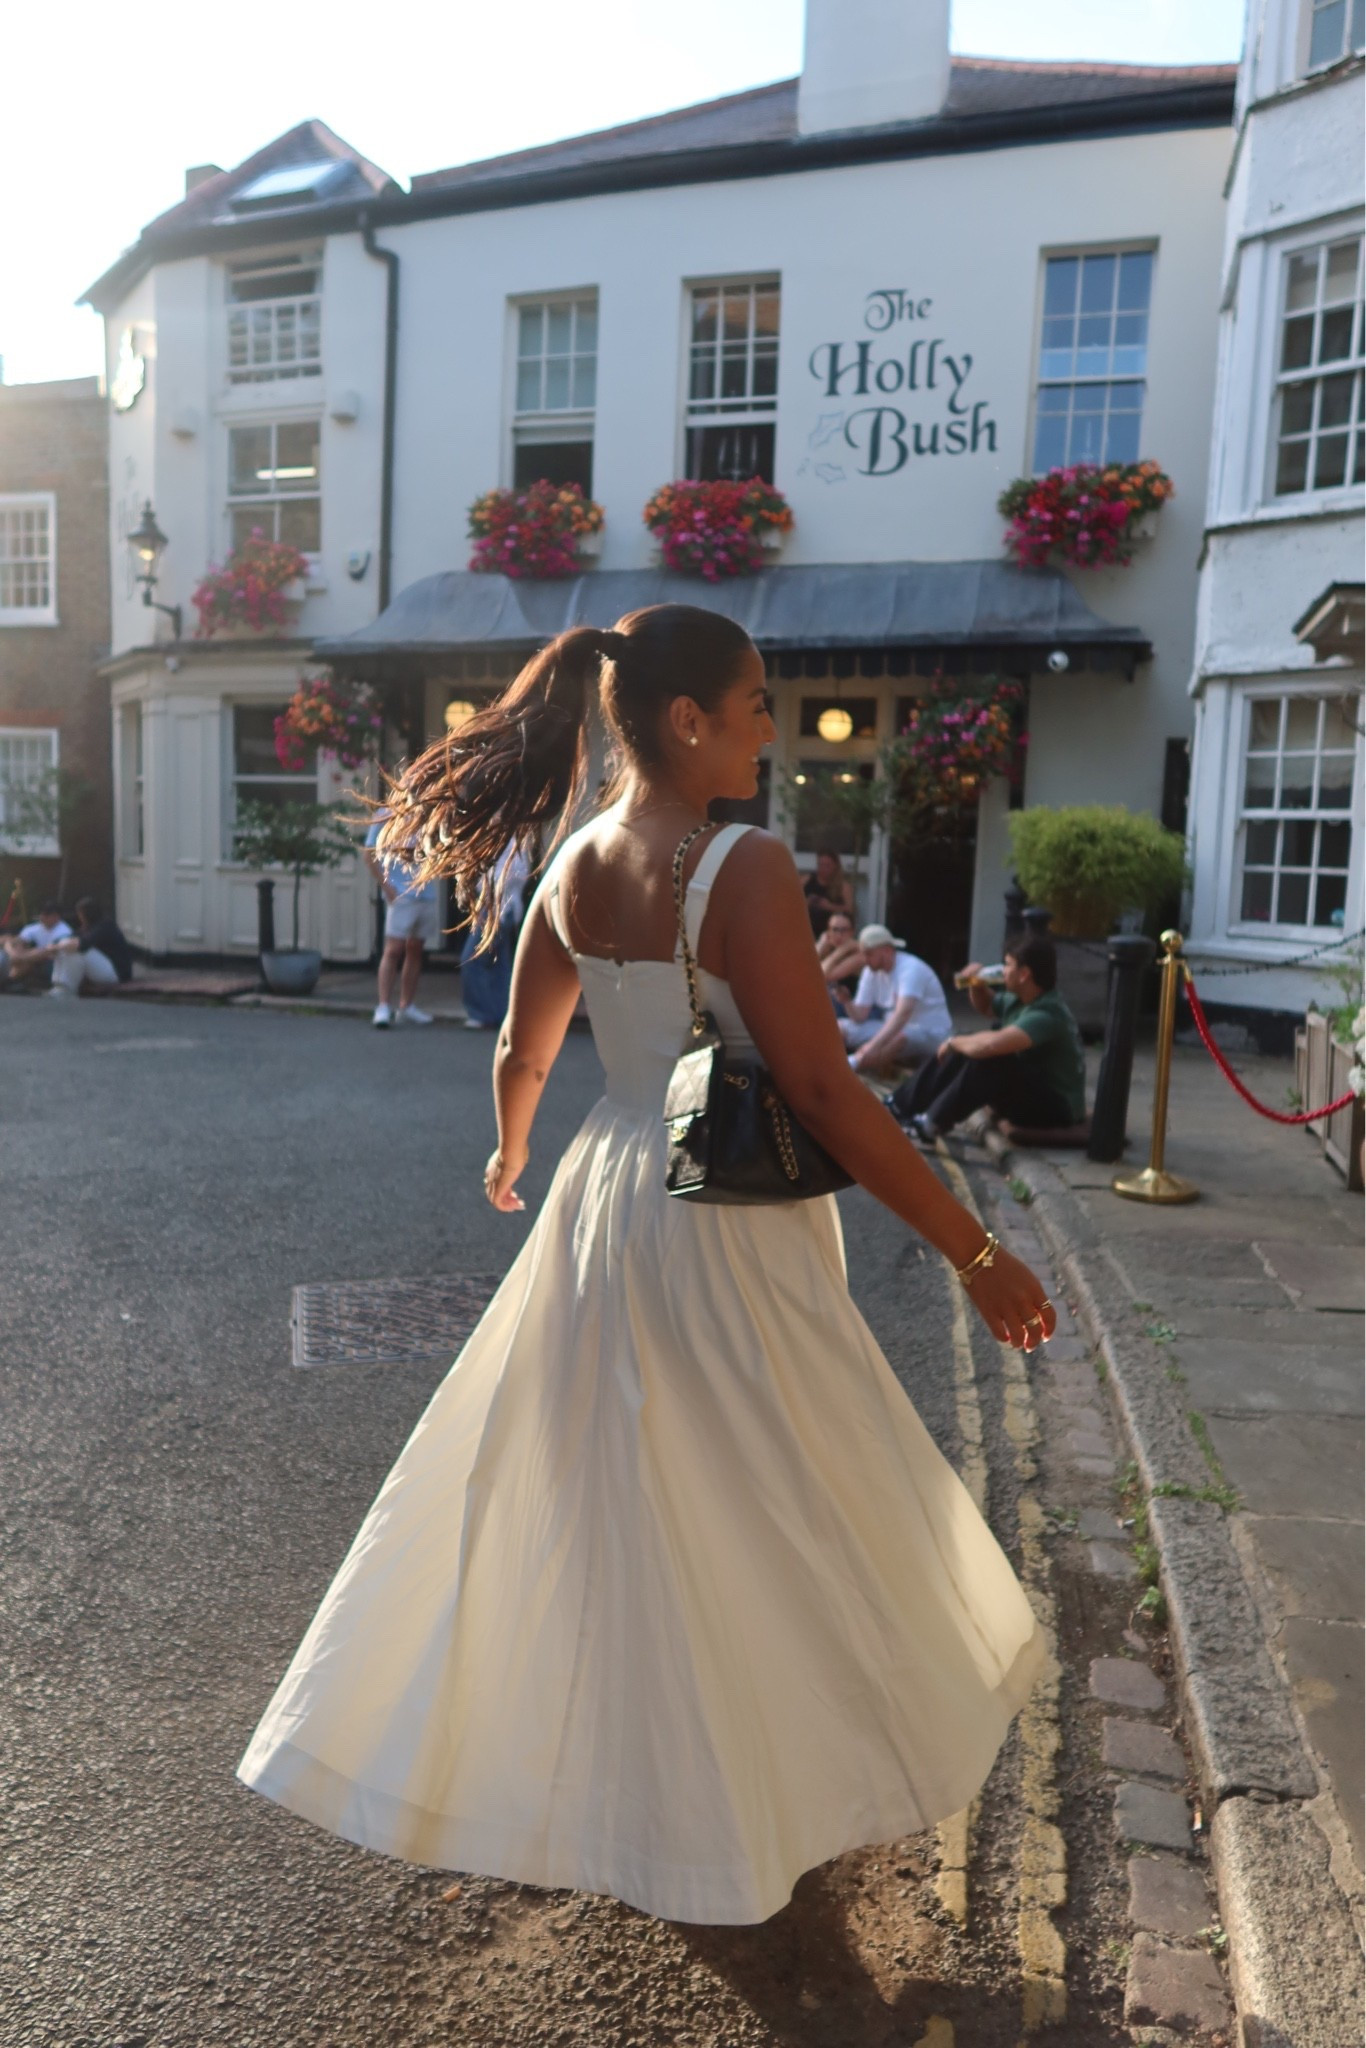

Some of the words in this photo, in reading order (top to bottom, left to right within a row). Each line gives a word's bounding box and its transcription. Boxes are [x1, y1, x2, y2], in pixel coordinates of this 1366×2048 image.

[864, 288, 933, 332] The
[808, 338, 973, 415] Holly
[844, 401, 998, 476] Bush
